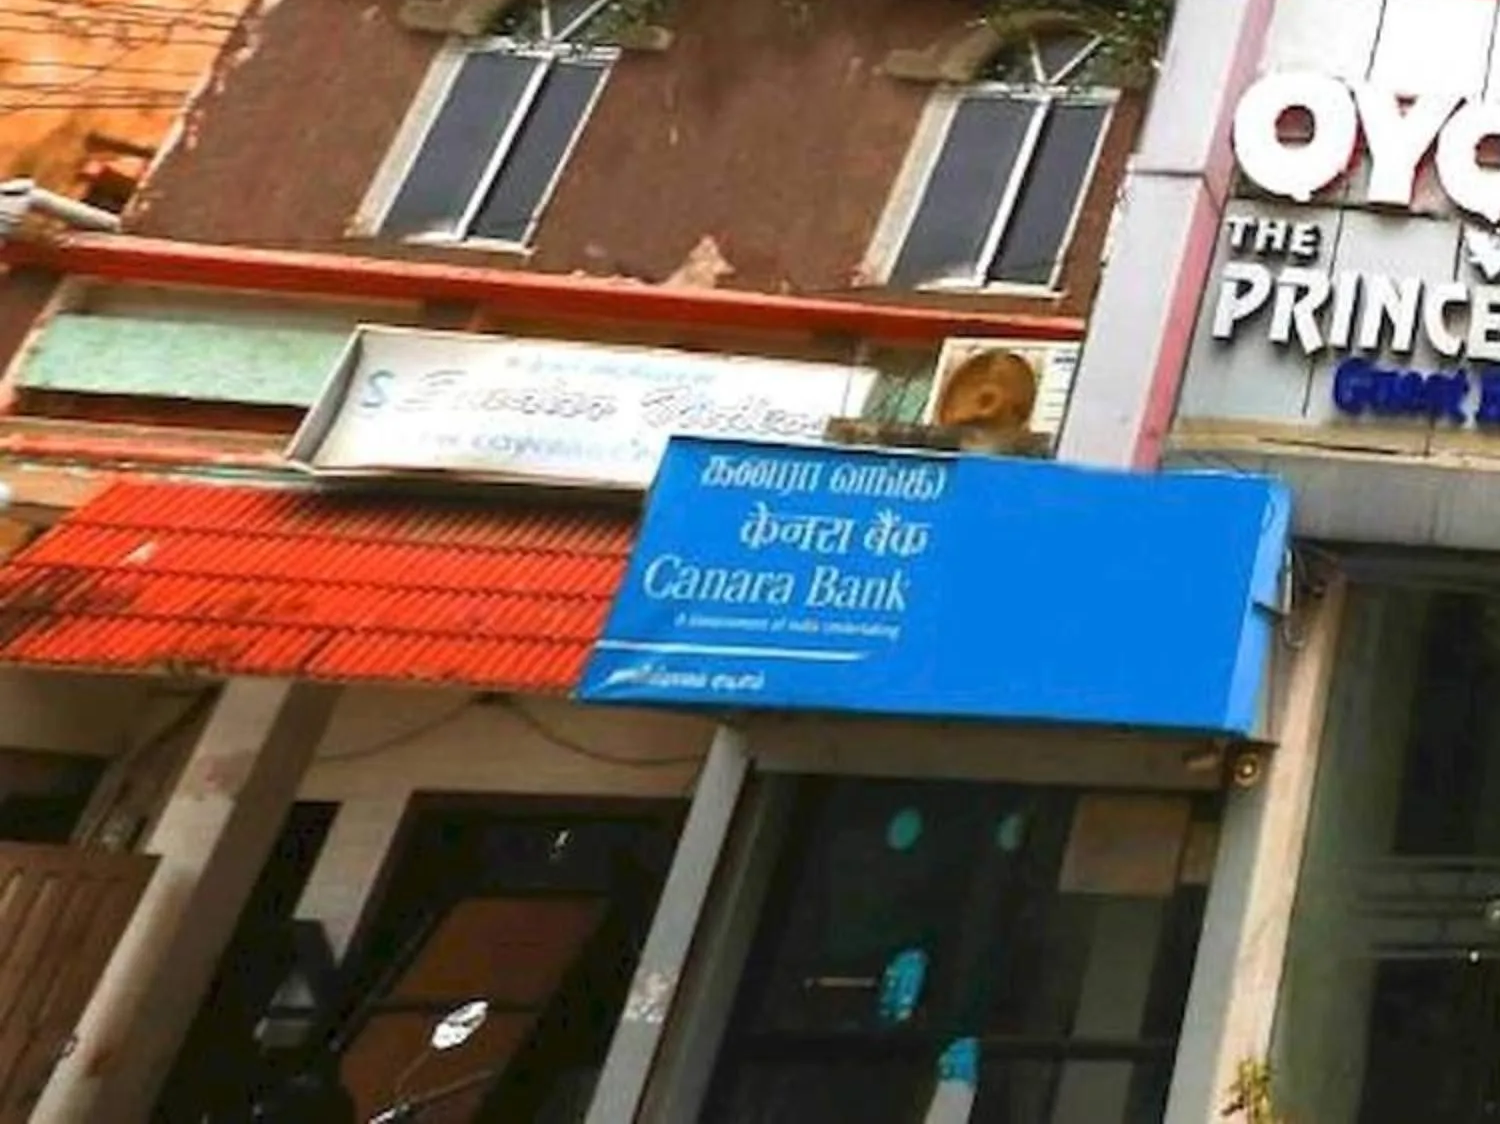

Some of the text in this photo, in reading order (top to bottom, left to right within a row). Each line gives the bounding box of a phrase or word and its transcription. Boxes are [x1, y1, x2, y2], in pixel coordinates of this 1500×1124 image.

[1227, 217, 1322, 257] THE
[1333, 357, 1469, 424] Guest
[643, 553, 912, 613] Canara Bank
